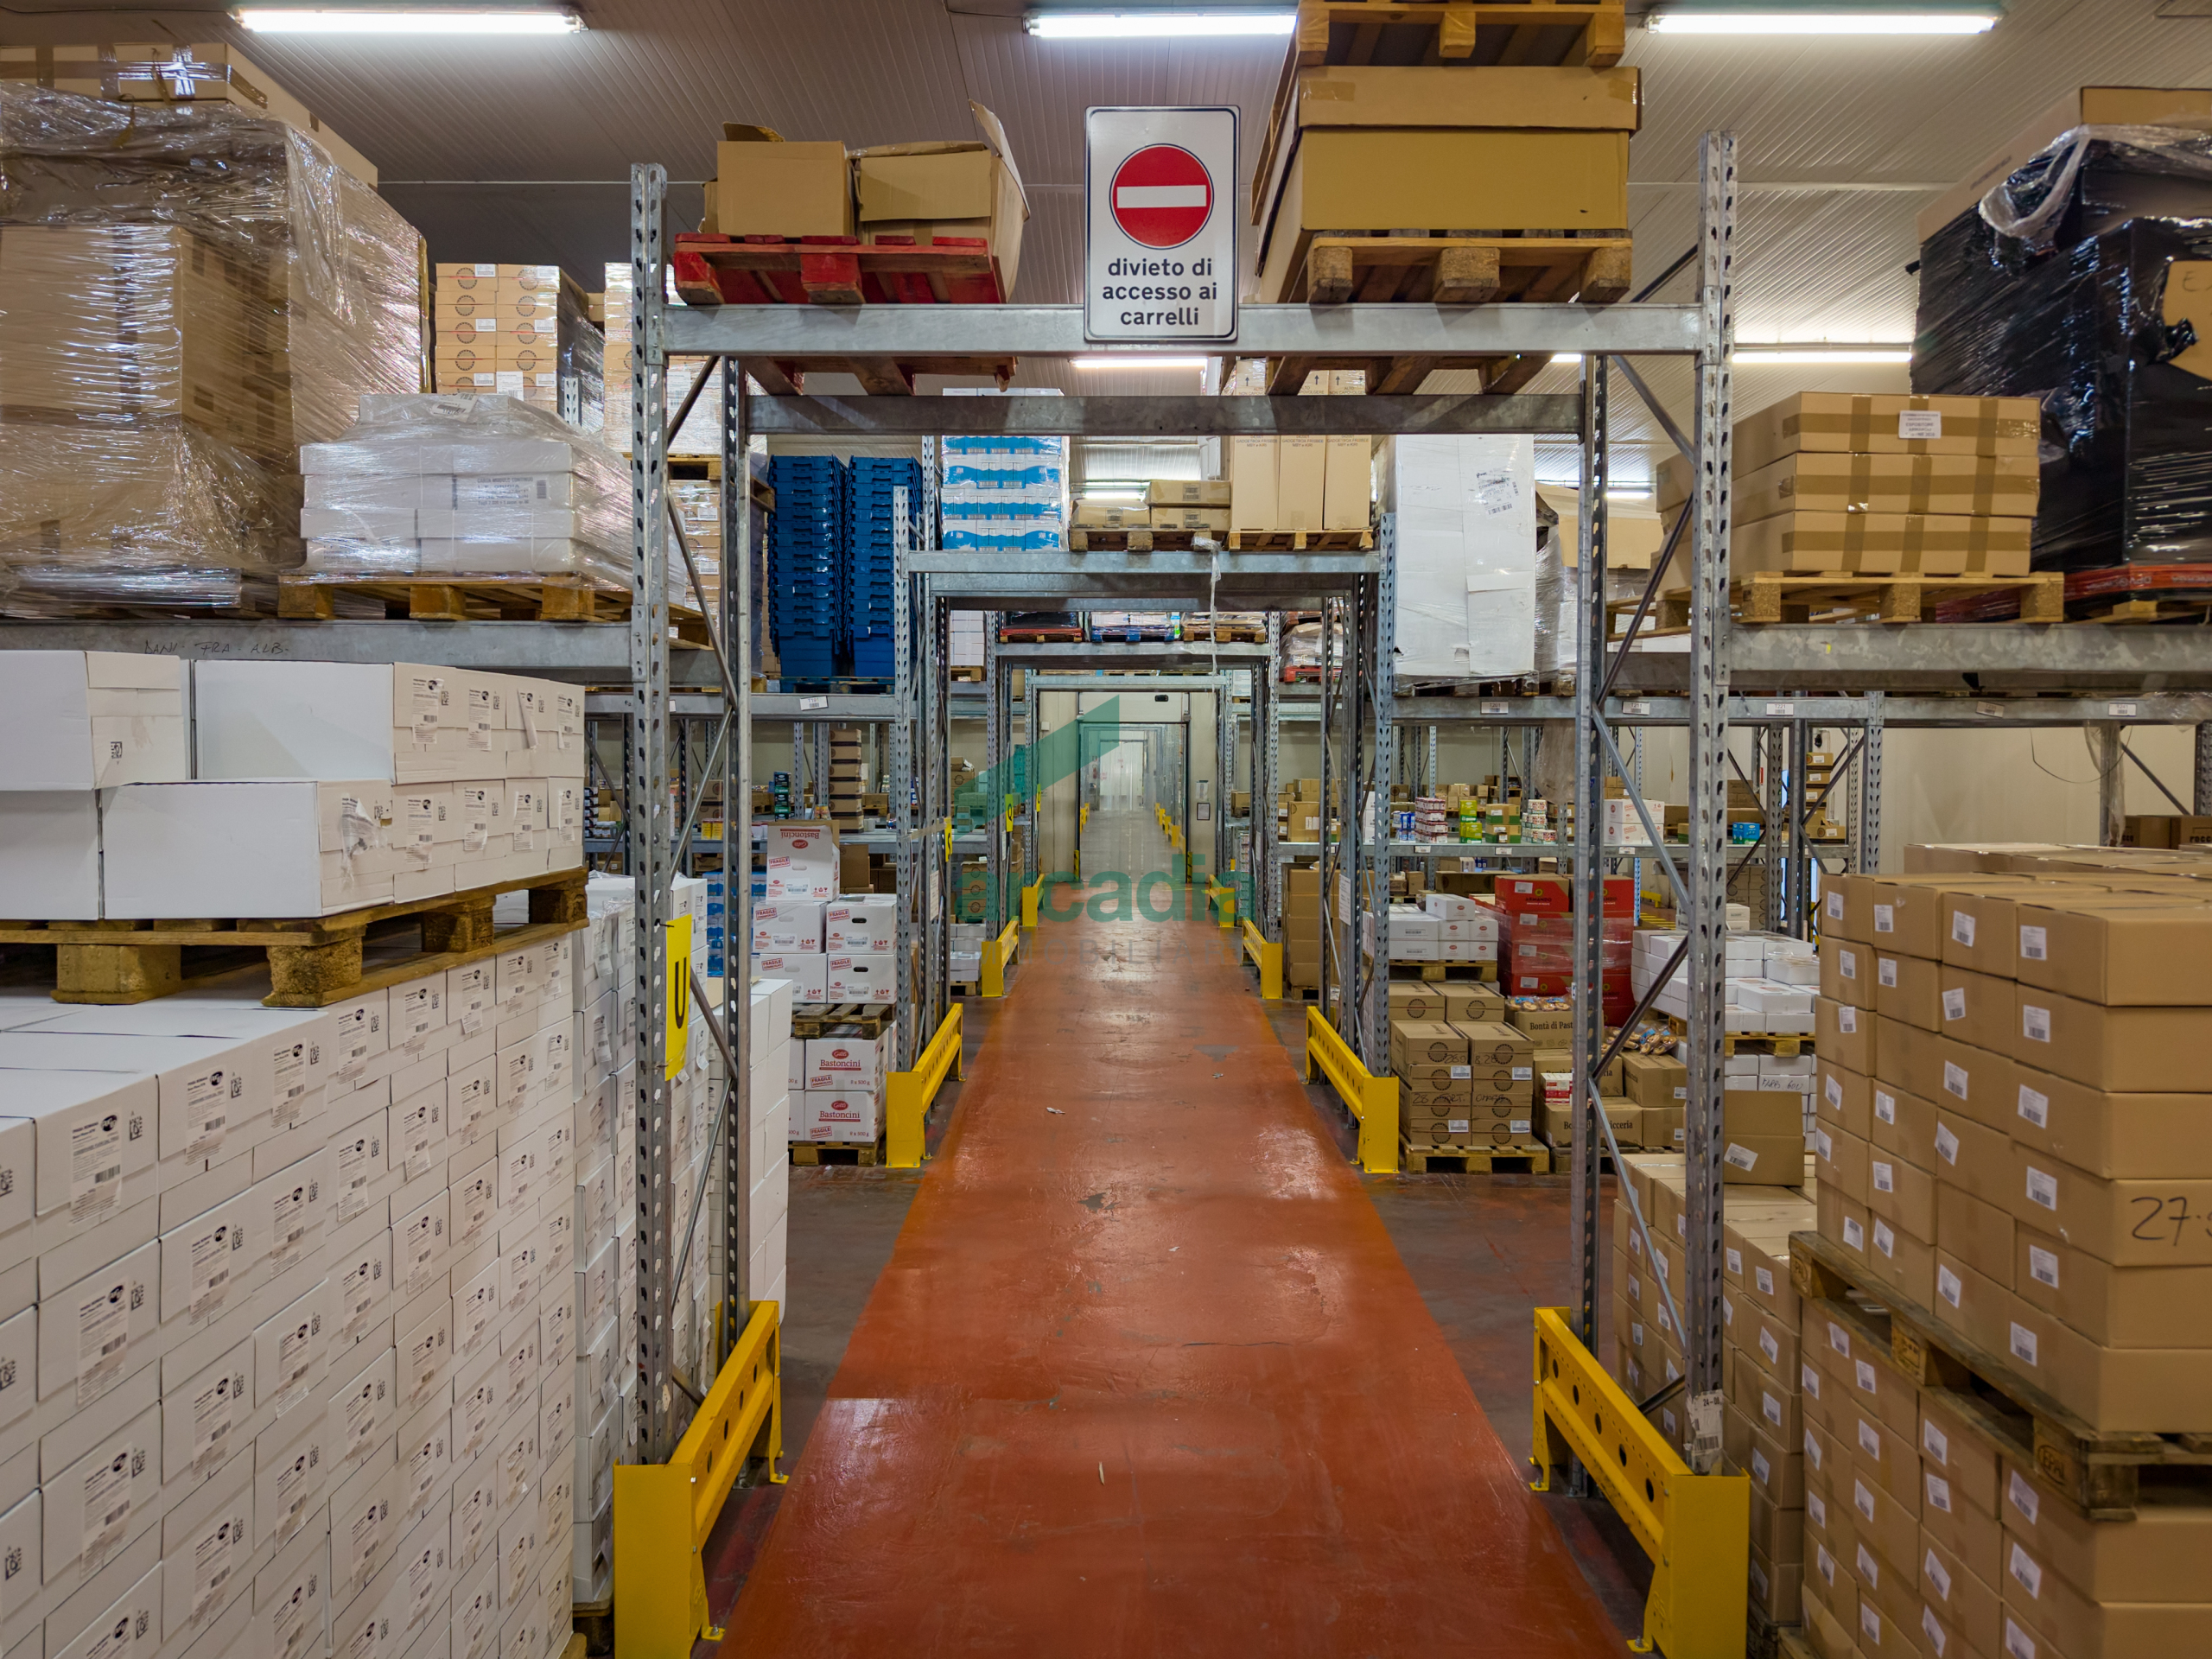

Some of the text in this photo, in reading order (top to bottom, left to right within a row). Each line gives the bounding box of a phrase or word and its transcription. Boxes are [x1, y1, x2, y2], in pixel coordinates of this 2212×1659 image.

[1108, 258, 1212, 276] divieto di
[1102, 282, 1217, 301] accesso ai
[1120, 308, 1199, 326] carrelli
[780, 831, 820, 840] Bastoncini
[674, 957, 687, 1030] U
[1529, 1021, 1550, 1031] Bontà
[820, 1059, 861, 1068] Bastoncini
[819, 1110, 860, 1119] Bastoncini
